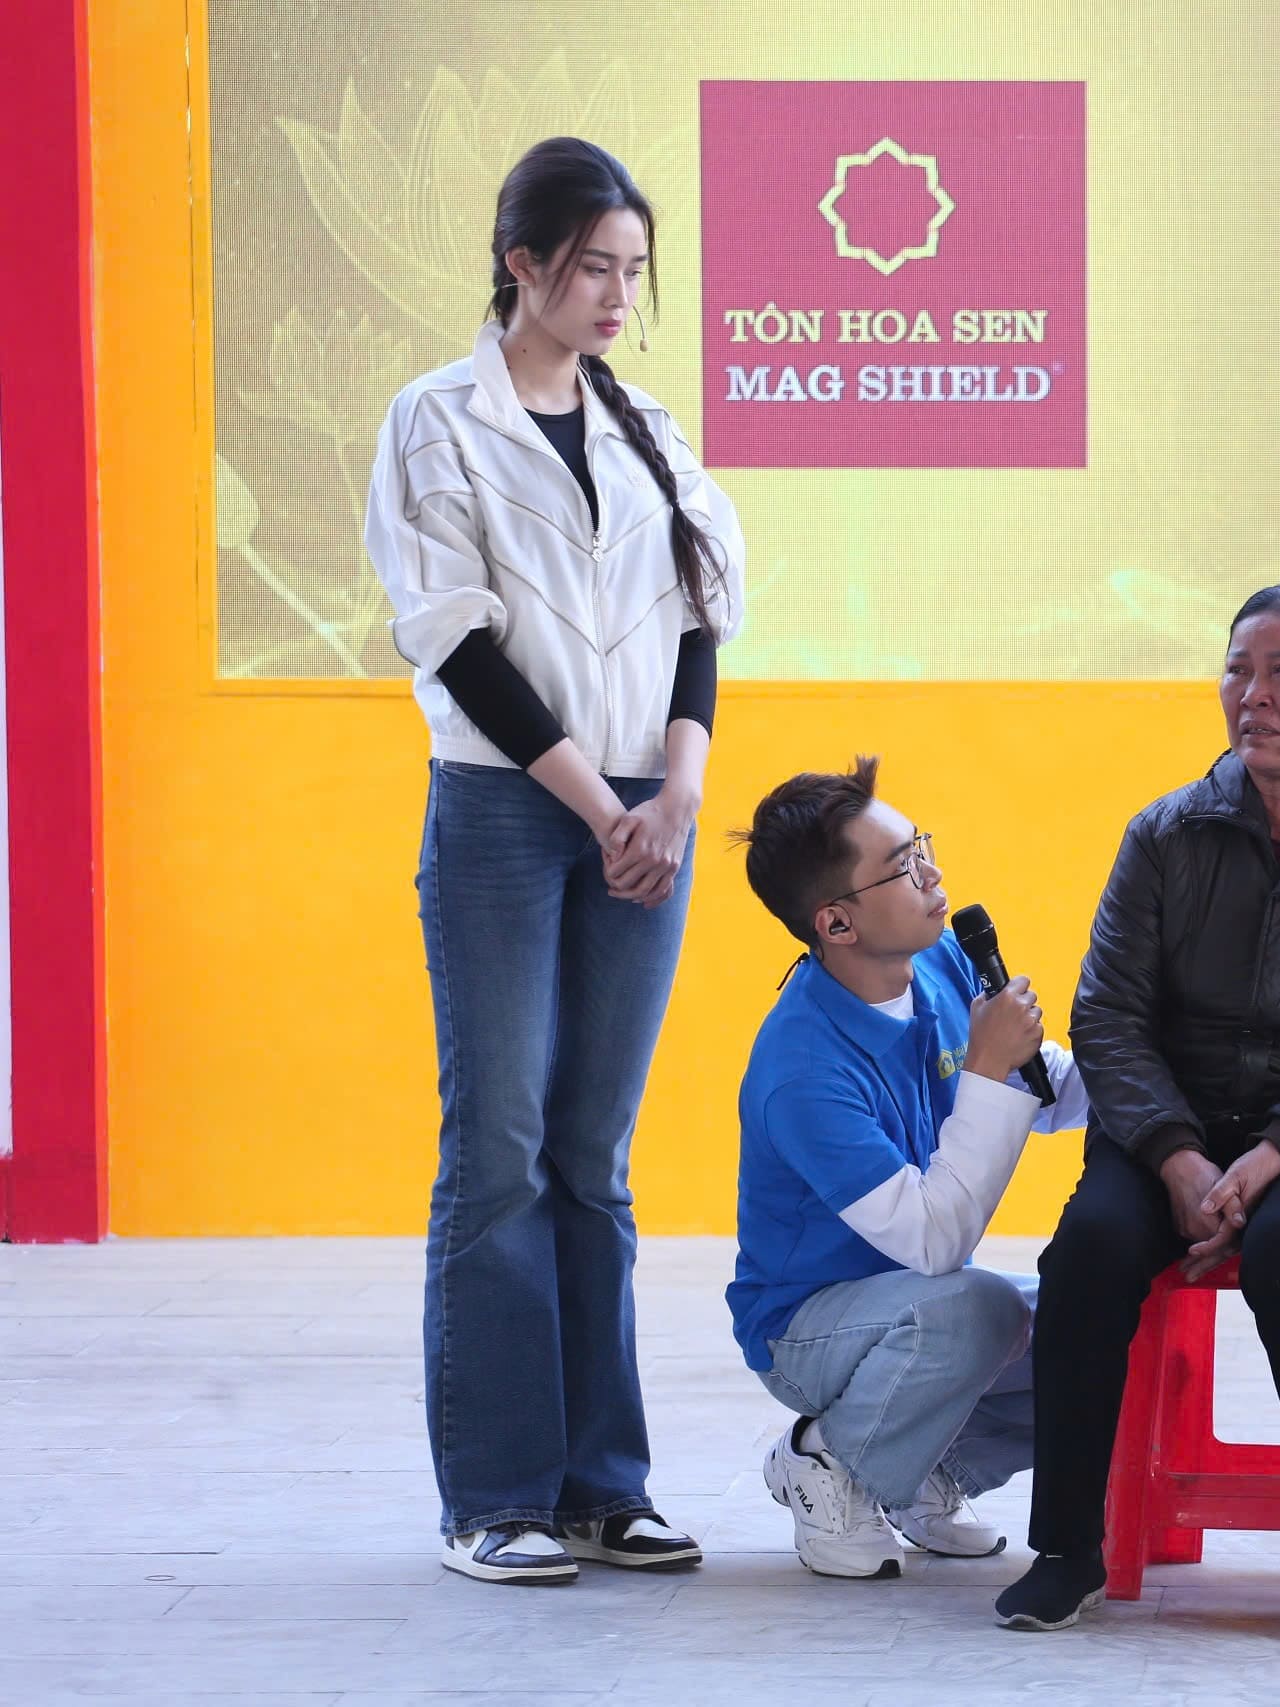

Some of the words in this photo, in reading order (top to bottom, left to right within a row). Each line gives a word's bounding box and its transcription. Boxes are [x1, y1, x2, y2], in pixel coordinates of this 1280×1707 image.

[724, 301, 824, 343] TÔN
[837, 309, 940, 343] HOA
[952, 309, 1048, 343] SEN
[725, 365, 844, 402] MAG
[857, 365, 1052, 402] SHIELD
[794, 1484, 814, 1514] FILA
